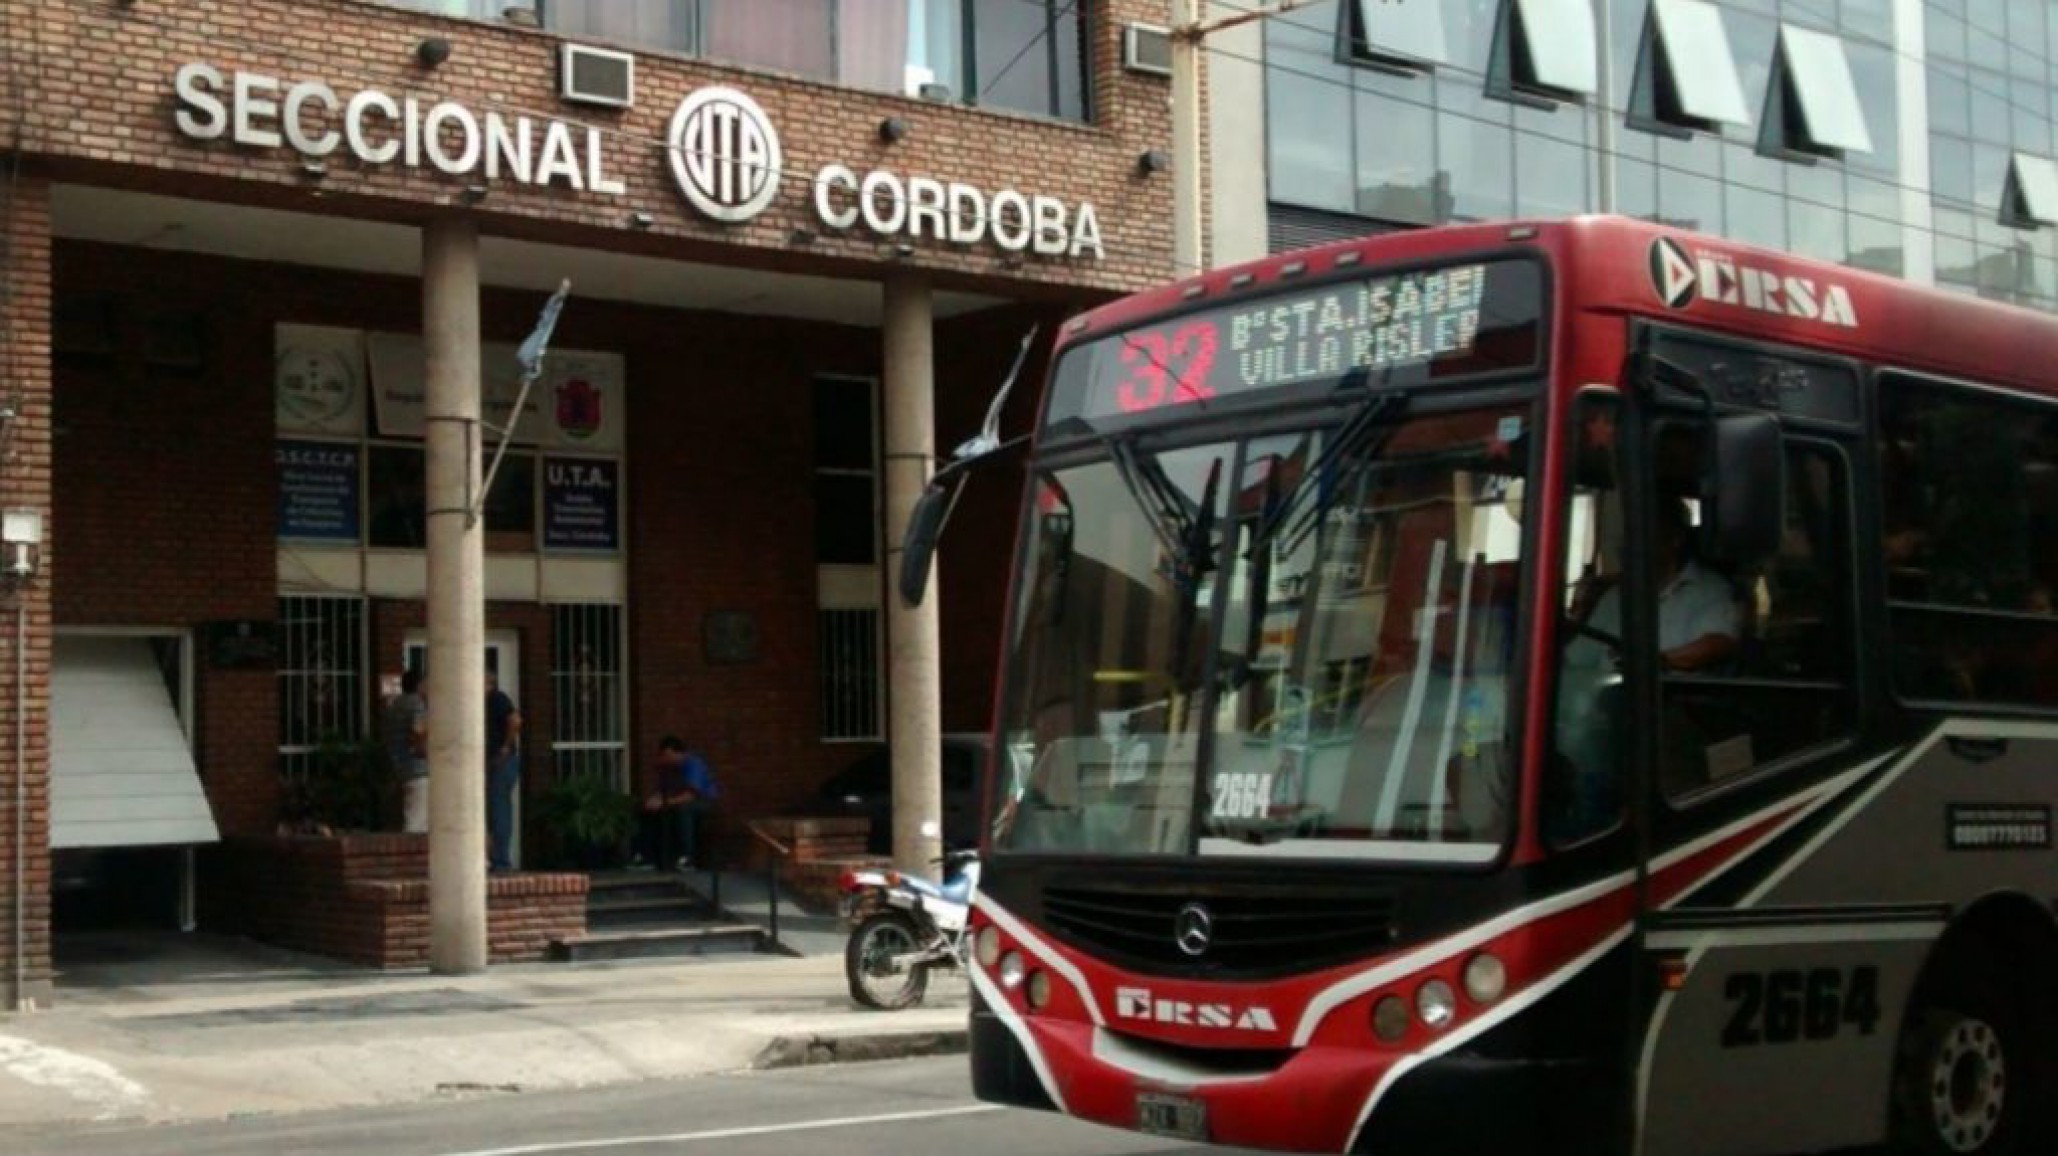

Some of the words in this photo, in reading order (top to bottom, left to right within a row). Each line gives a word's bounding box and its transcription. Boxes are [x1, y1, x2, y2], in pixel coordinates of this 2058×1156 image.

[175, 62, 626, 195] SECCIONAL
[814, 164, 1105, 259] CORDOBA
[1697, 257, 1860, 328] ERSA
[1115, 320, 1219, 413] 32
[1239, 336, 1342, 386] VILLA
[548, 464, 612, 487] U.T.A.
[1212, 771, 1272, 820] 2664
[1115, 985, 1278, 1032] ERSA
[1721, 966, 1882, 1050] 2664
